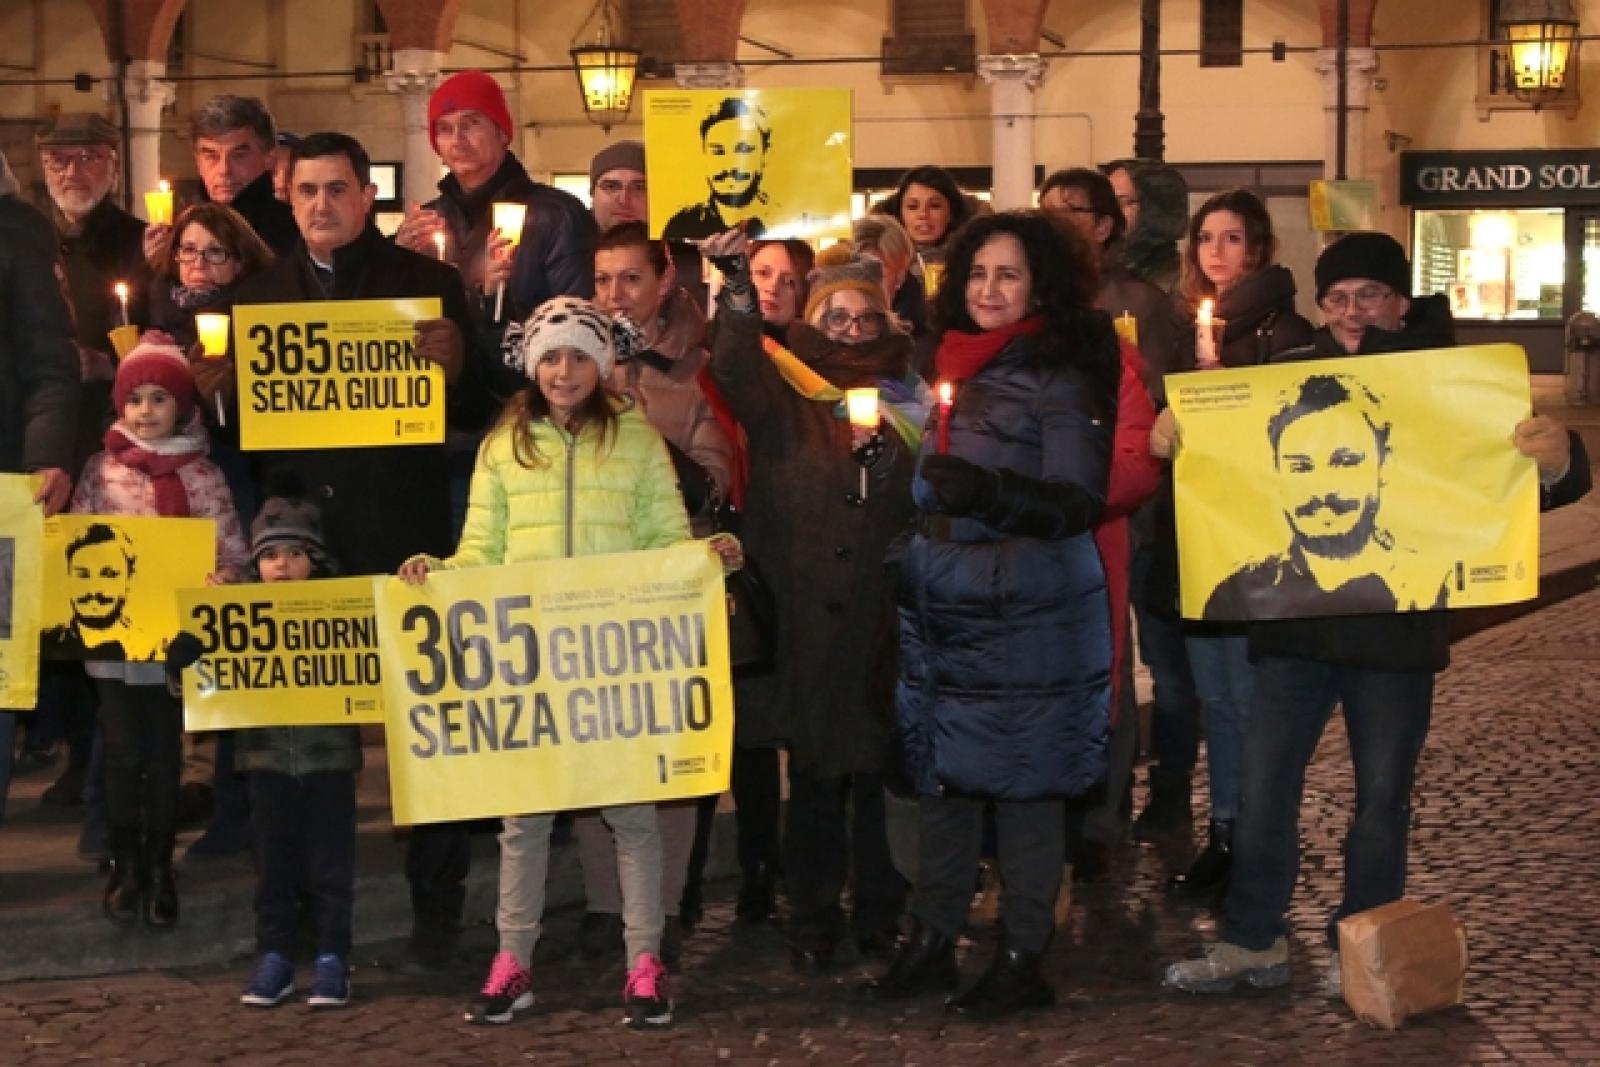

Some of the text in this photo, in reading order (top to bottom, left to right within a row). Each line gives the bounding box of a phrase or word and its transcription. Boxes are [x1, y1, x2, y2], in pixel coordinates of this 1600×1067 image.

[1417, 164, 1532, 191] GRAND
[248, 322, 331, 376] 365
[252, 375, 431, 414] SENZA GIULIO
[191, 601, 379, 654] 365 GIORNI
[401, 594, 709, 696] 365 GIORNI
[194, 652, 381, 691] SENZA GIULIO
[409, 675, 711, 760] SENZA GIULIO
